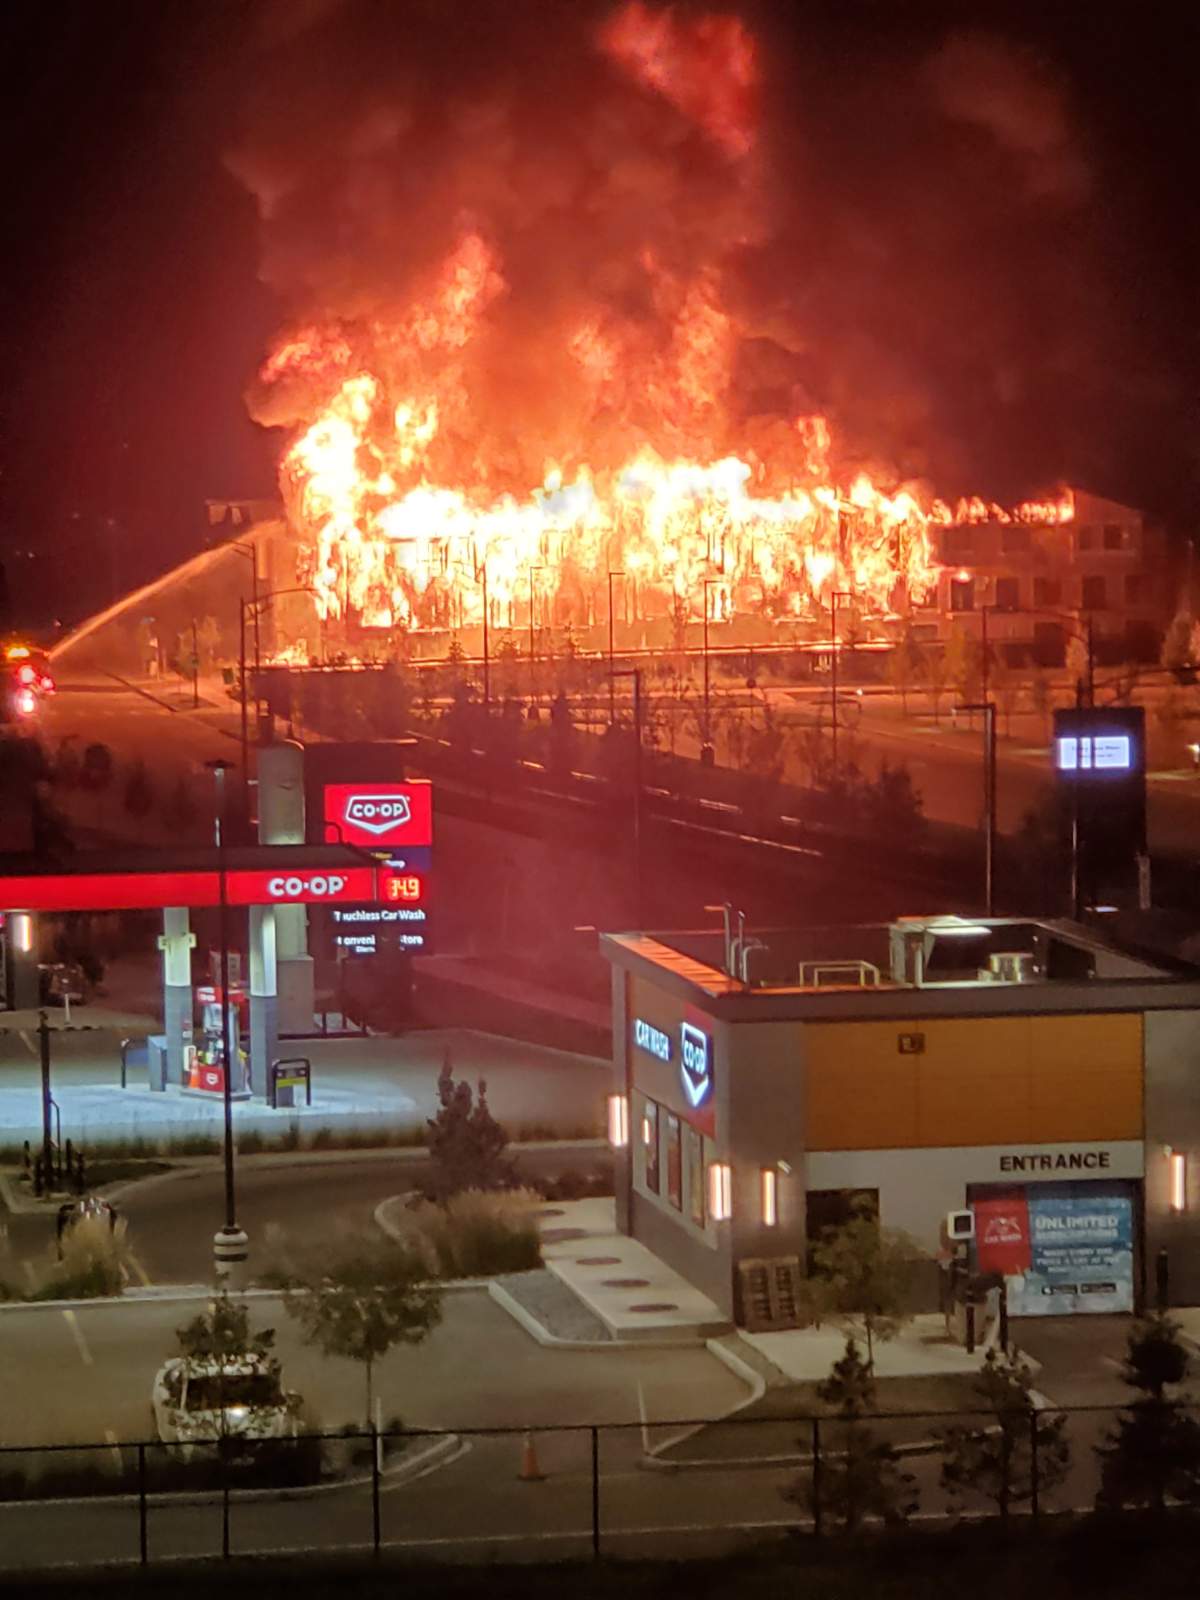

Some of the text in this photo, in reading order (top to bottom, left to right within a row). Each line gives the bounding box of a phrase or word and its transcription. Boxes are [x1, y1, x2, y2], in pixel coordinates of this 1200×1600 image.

[380, 910, 397, 921] Car
[398, 908, 426, 921] Wash
[400, 934, 424, 946] tore
[1000, 1152, 1110, 1172] ENTRANCE
[1035, 1214, 1119, 1230] UNLIMITED
